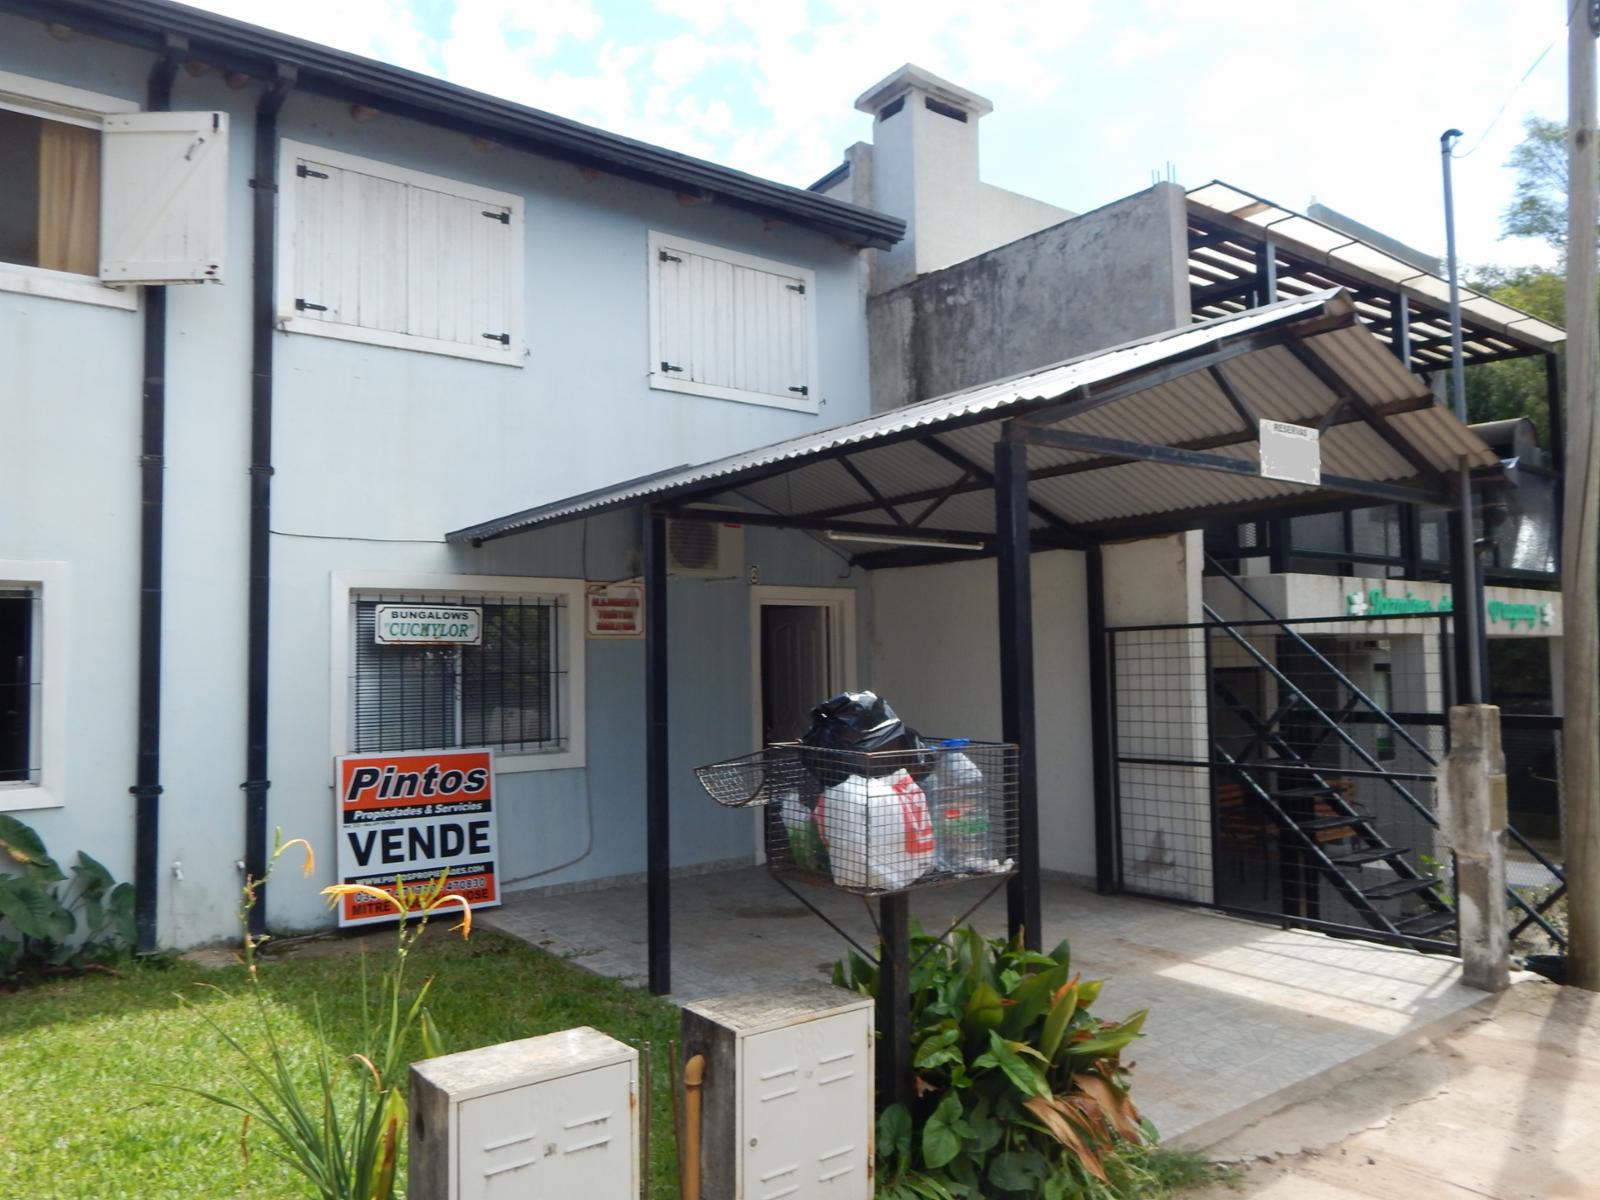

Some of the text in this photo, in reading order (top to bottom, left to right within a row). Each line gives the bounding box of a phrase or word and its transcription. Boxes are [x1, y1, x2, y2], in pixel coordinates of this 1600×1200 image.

[1273, 423, 1308, 437] RESERVAS
[391, 611, 469, 620] BUNGALOWS
[346, 764, 488, 802] Pintos
[353, 802, 483, 821] Propiedades & Servicios
[347, 820, 491, 866] VENDE
[352, 904, 391, 915] MITRE
